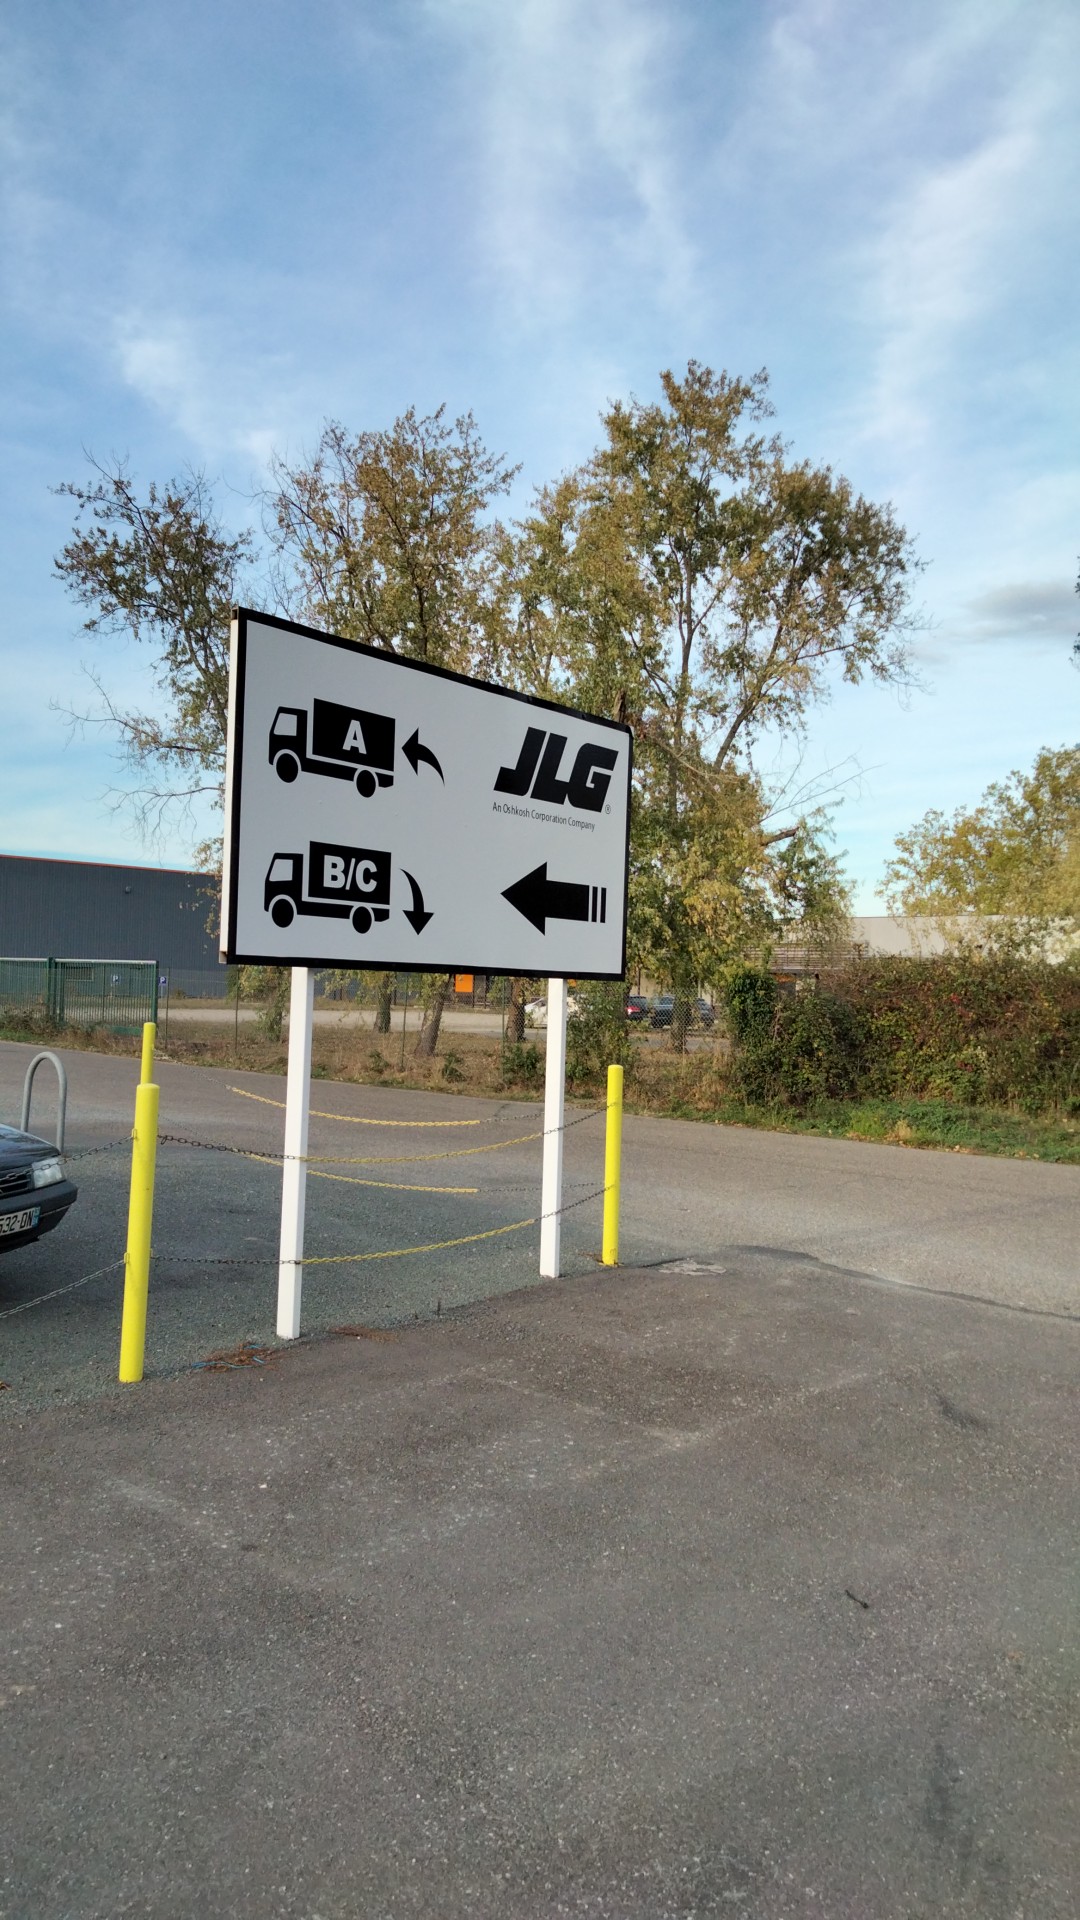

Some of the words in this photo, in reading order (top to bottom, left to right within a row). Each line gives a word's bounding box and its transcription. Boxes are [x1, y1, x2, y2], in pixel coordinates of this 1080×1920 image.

[342, 719, 367, 755] A
[493, 726, 619, 813] JLG
[492, 801, 502, 813] An
[502, 803, 530, 818] Oshkosh
[531, 809, 567, 825] Corporation
[568, 816, 596, 832] Company
[322, 854, 378, 893] B/C
